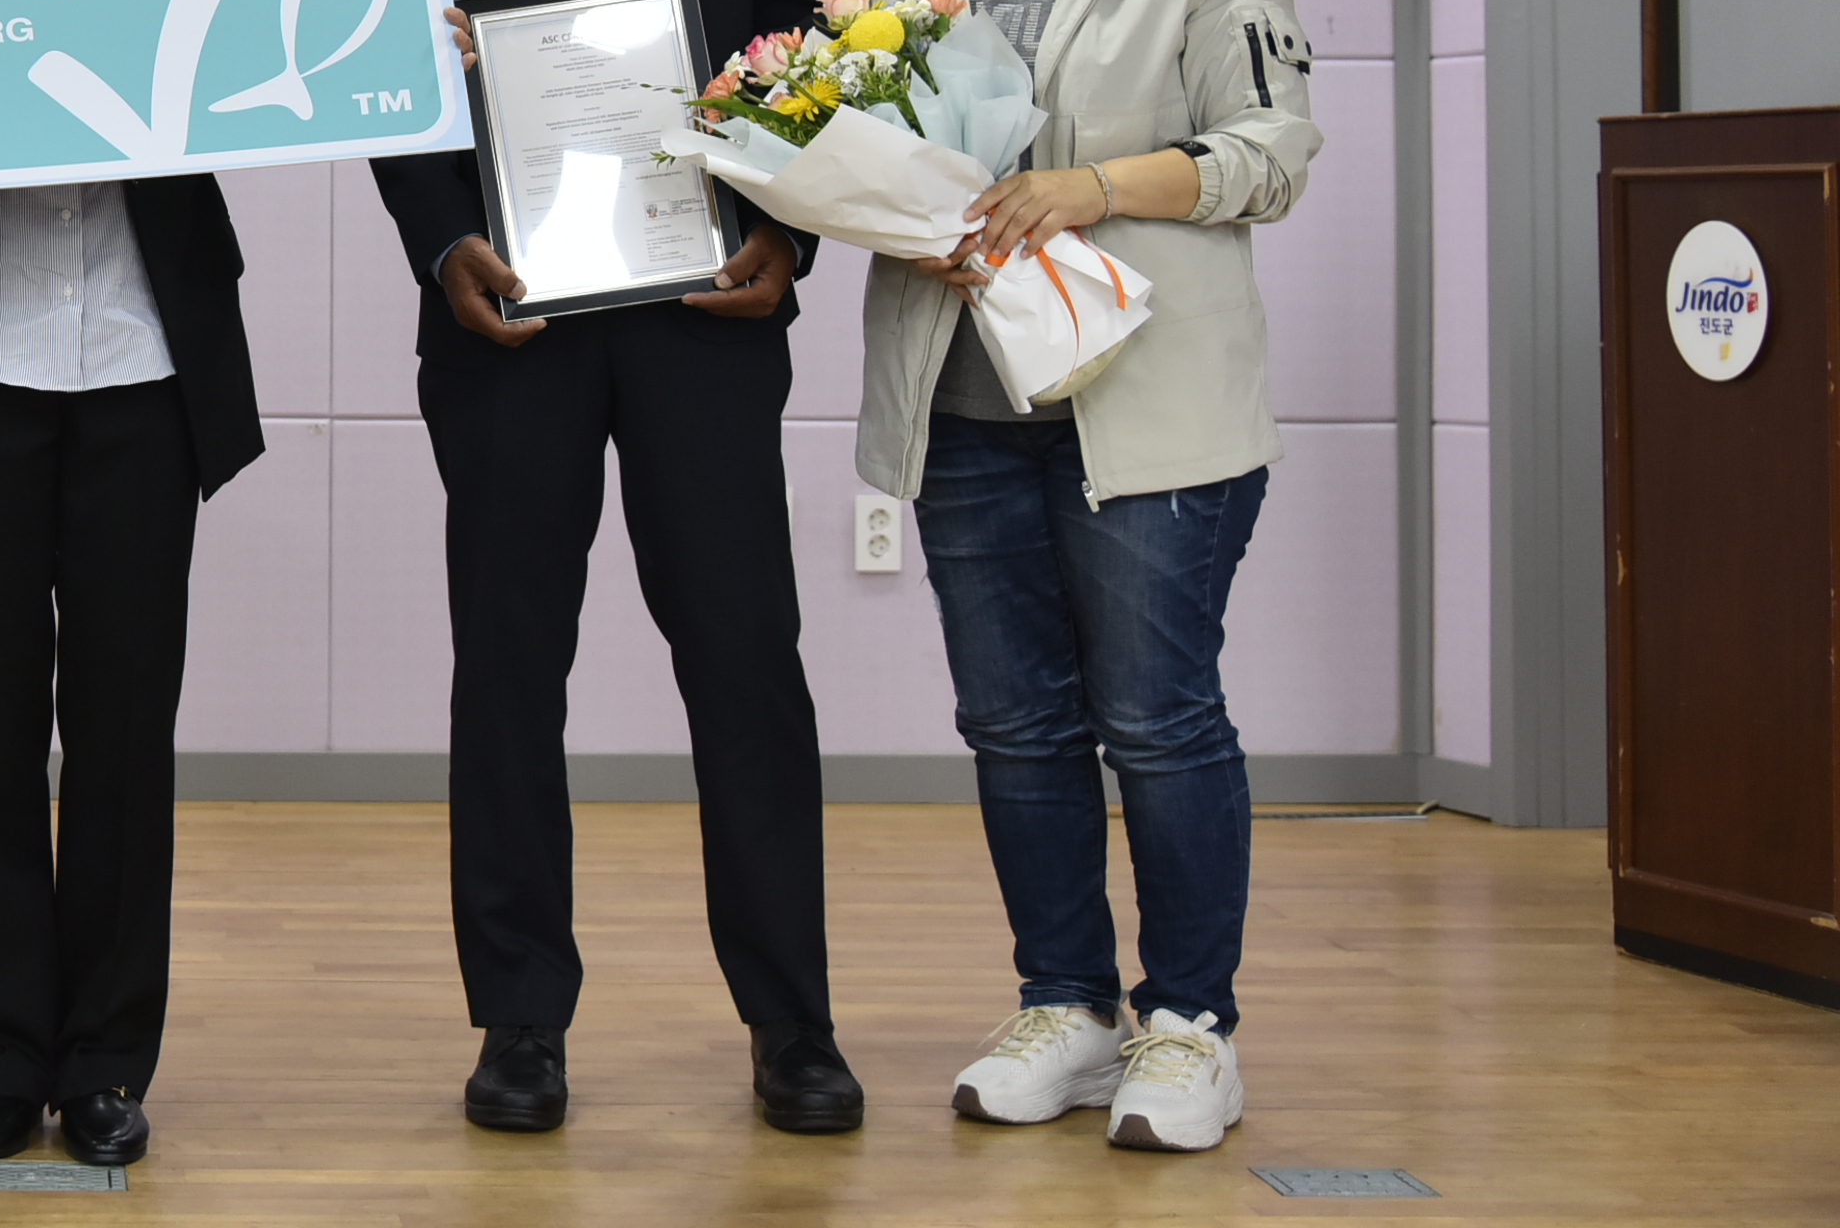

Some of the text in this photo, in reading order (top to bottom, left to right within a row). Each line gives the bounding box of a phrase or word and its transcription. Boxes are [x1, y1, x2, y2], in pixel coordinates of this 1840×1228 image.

[352, 88, 414, 117] TM
[1675, 282, 1745, 313] Jindo
[1699, 317, 1734, 336] 진도군
